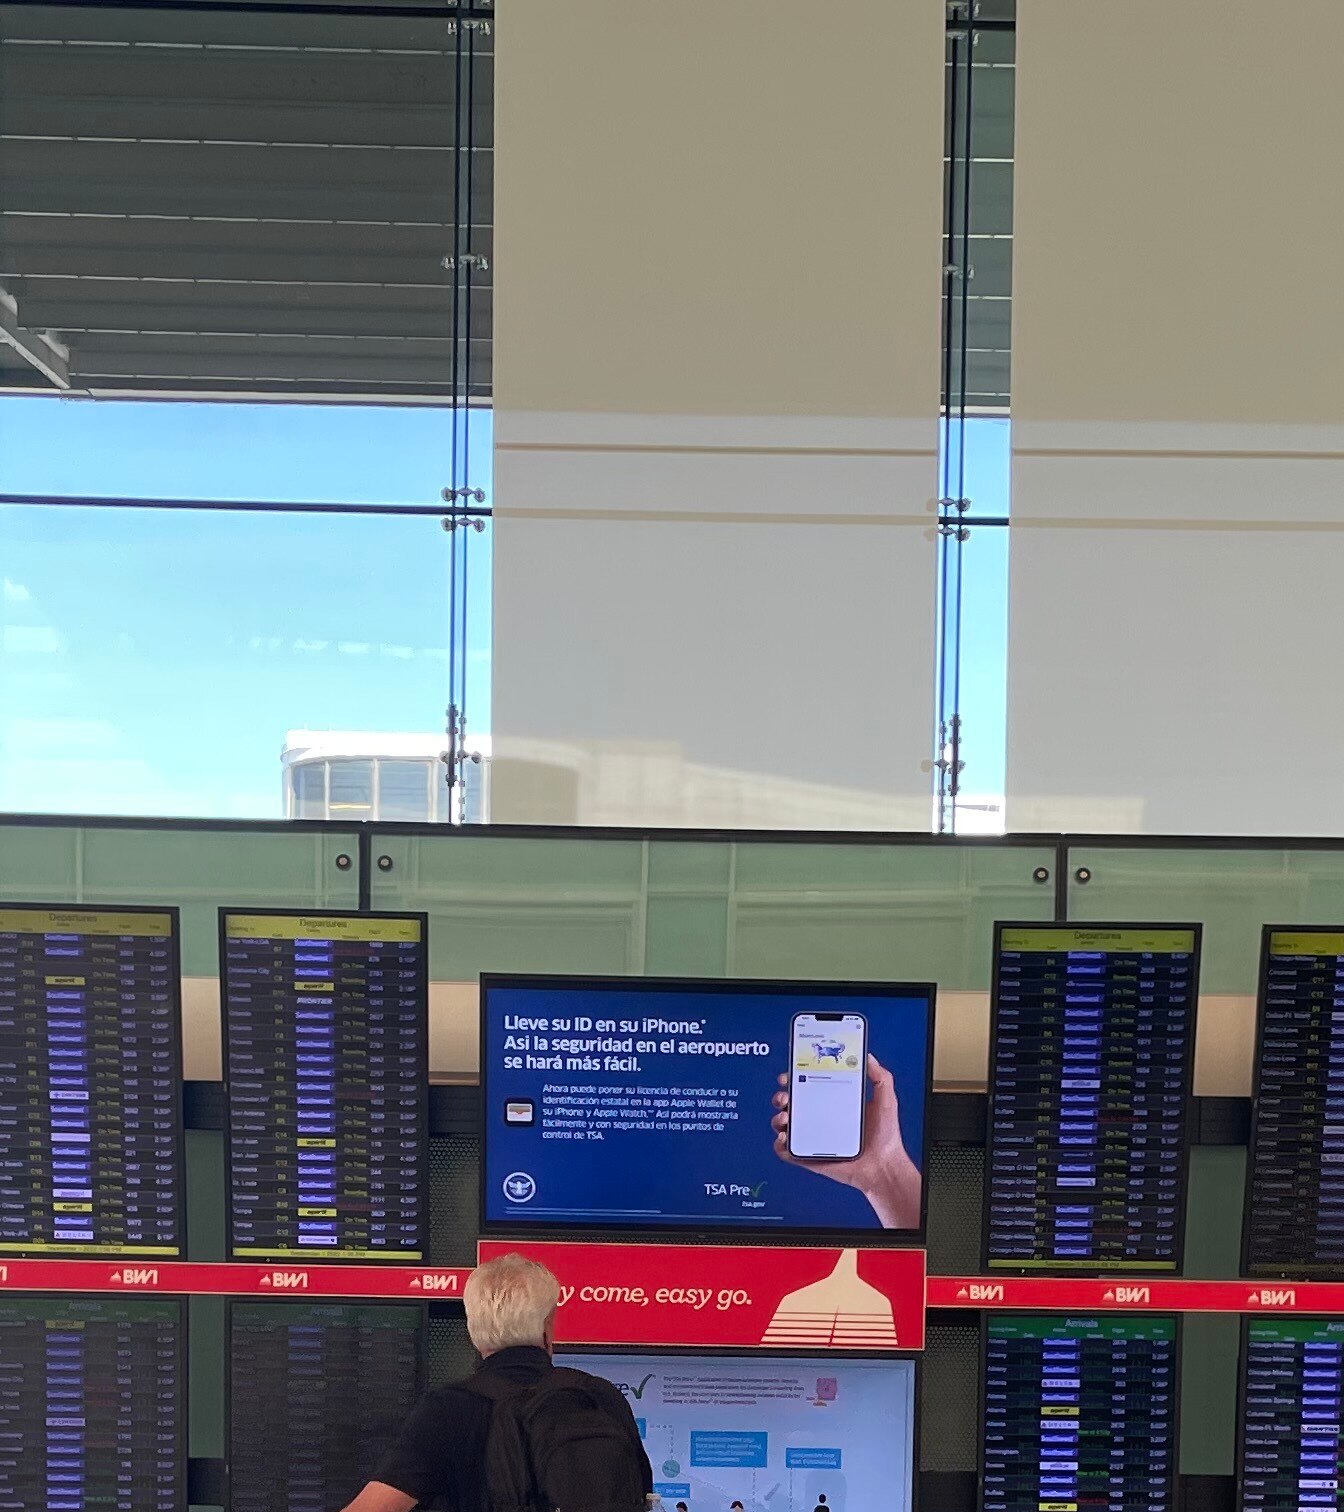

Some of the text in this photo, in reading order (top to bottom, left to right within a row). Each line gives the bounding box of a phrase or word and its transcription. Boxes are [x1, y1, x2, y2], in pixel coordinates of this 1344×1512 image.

[48, 912, 98, 922] Departures
[298, 919, 348, 928] Departures
[504, 1015, 549, 1031] Lleve
[552, 1019, 571, 1031] su
[574, 1017, 592, 1032] ID
[596, 1020, 616, 1032] en
[620, 1021, 638, 1032] su
[534, 1036, 548, 1050] la
[552, 1037, 633, 1054] seguridad
[636, 1041, 656, 1053] en
[660, 1040, 676, 1054] el
[678, 1042, 770, 1056] aeropuerto
[504, 1054, 642, 1072] se hará más fácil.
[543, 1084, 568, 1093] Ahora
[570, 1085, 596, 1095] puede
[598, 1085, 623, 1095] poner
[625, 1086, 636, 1095] su
[670, 1087, 681, 1095] de
[682, 1087, 719, 1096] conducir
[728, 1088, 738, 1096] su
[631, 1098, 641, 1106] en
[653, 1099, 669, 1108] app
[671, 1098, 696, 1108] Apple
[725, 1100, 737, 1108] de
[543, 1107, 552, 1115] su
[554, 1107, 583, 1117] iPhone
[593, 1108, 618, 1117] Apple
[613, 1120, 655, 1130] seguridad
[669, 1121, 682, 1129] los
[683, 1122, 712, 1131] puntos
[713, 1123, 725, 1131] de
[543, 1131, 572, 1139] control
[573, 1131, 585, 1139] de
[704, 1183, 750, 1196] TSA Pre
[122, 1269, 159, 1285] BWI
[272, 1272, 308, 1288] BWI
[421, 1275, 458, 1291] BWI
[580, 1286, 648, 1306] come,
[654, 1289, 714, 1311] easy
[718, 1291, 753, 1310] go.
[969, 1285, 1004, 1301] BWI
[1115, 1288, 1150, 1303] BWI
[1260, 1290, 1296, 1306] BWI
